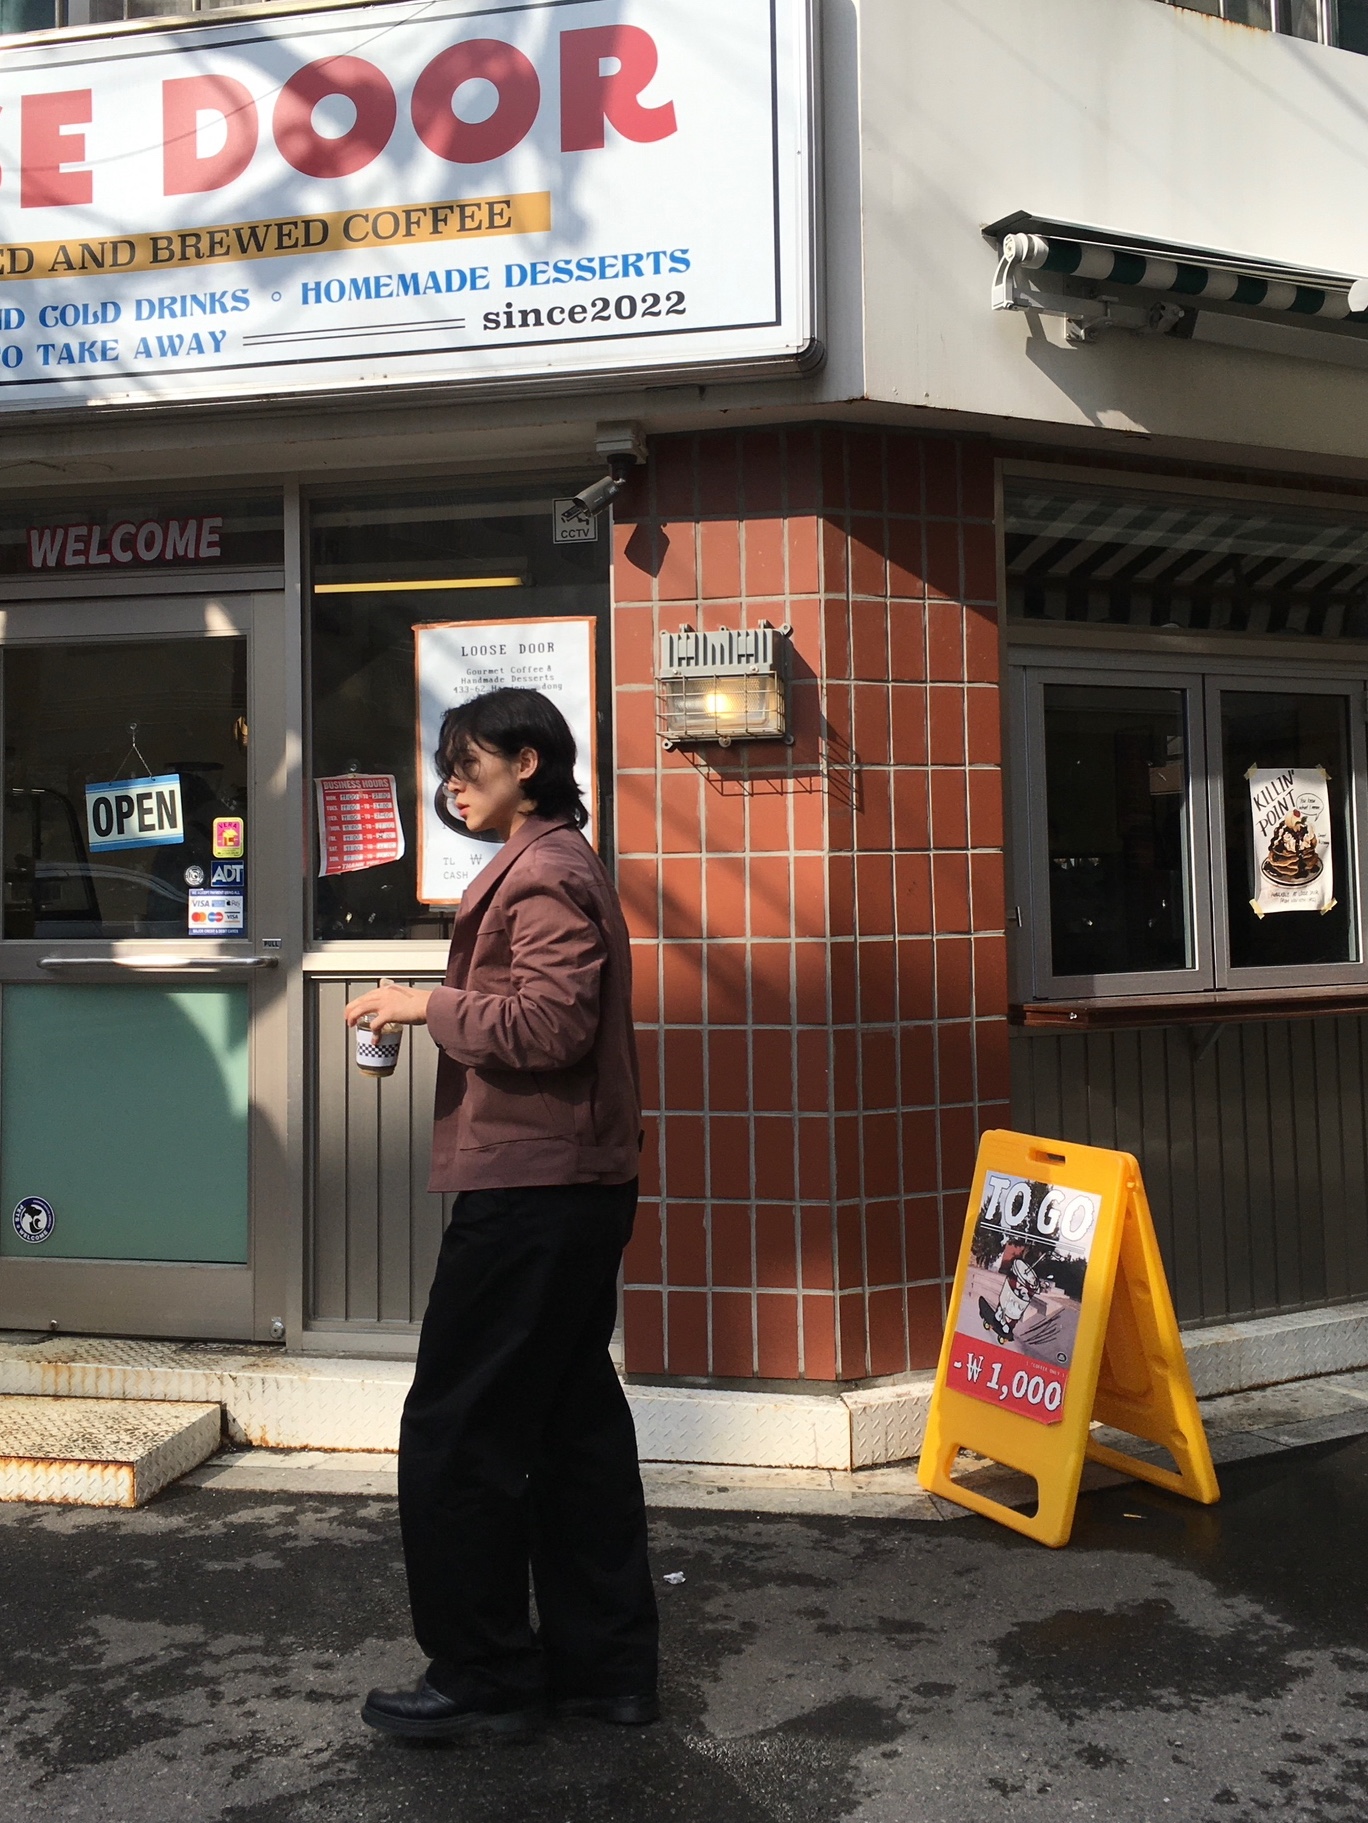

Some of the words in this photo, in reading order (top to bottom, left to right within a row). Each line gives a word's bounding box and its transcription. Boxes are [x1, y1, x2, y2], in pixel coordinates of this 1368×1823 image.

[162, 24, 678, 196] DOOR
[47, 239, 136, 273] AND
[149, 219, 329, 264] BREWED
[342, 200, 512, 243] COFFEE
[38, 301, 122, 330] COLD
[134, 289, 250, 324] DRINKS
[301, 266, 490, 306] HOMEMADE
[504, 249, 691, 288] DESSERTS
[482, 291, 687, 331] since2022
[36, 339, 119, 367] TAKE
[133, 330, 227, 359] AWAY
[28, 516, 223, 568] WELCOME
[560, 528, 590, 540] CCTV
[461, 644, 507, 657] LOOSE
[519, 642, 555, 654] DOOR
[453, 685, 486, 694] 433-62
[461, 676, 505, 684] Handmade
[511, 674, 555, 682] Desserts
[466, 667, 505, 676] Gourmet
[510, 666, 544, 674] Coffee
[323, 780, 361, 790] BUSINESS
[362, 779, 389, 788] HOURS
[1253, 769, 1295, 812] KILLIN'
[91, 789, 178, 837] OPEN
[1258, 789, 1297, 837] POINT
[211, 865, 244, 882] ADT
[443, 871, 469, 880] CASH
[985, 1175, 1032, 1226] TO
[1037, 1189, 1095, 1241] GO
[19, 1229, 48, 1241] WELCOME
